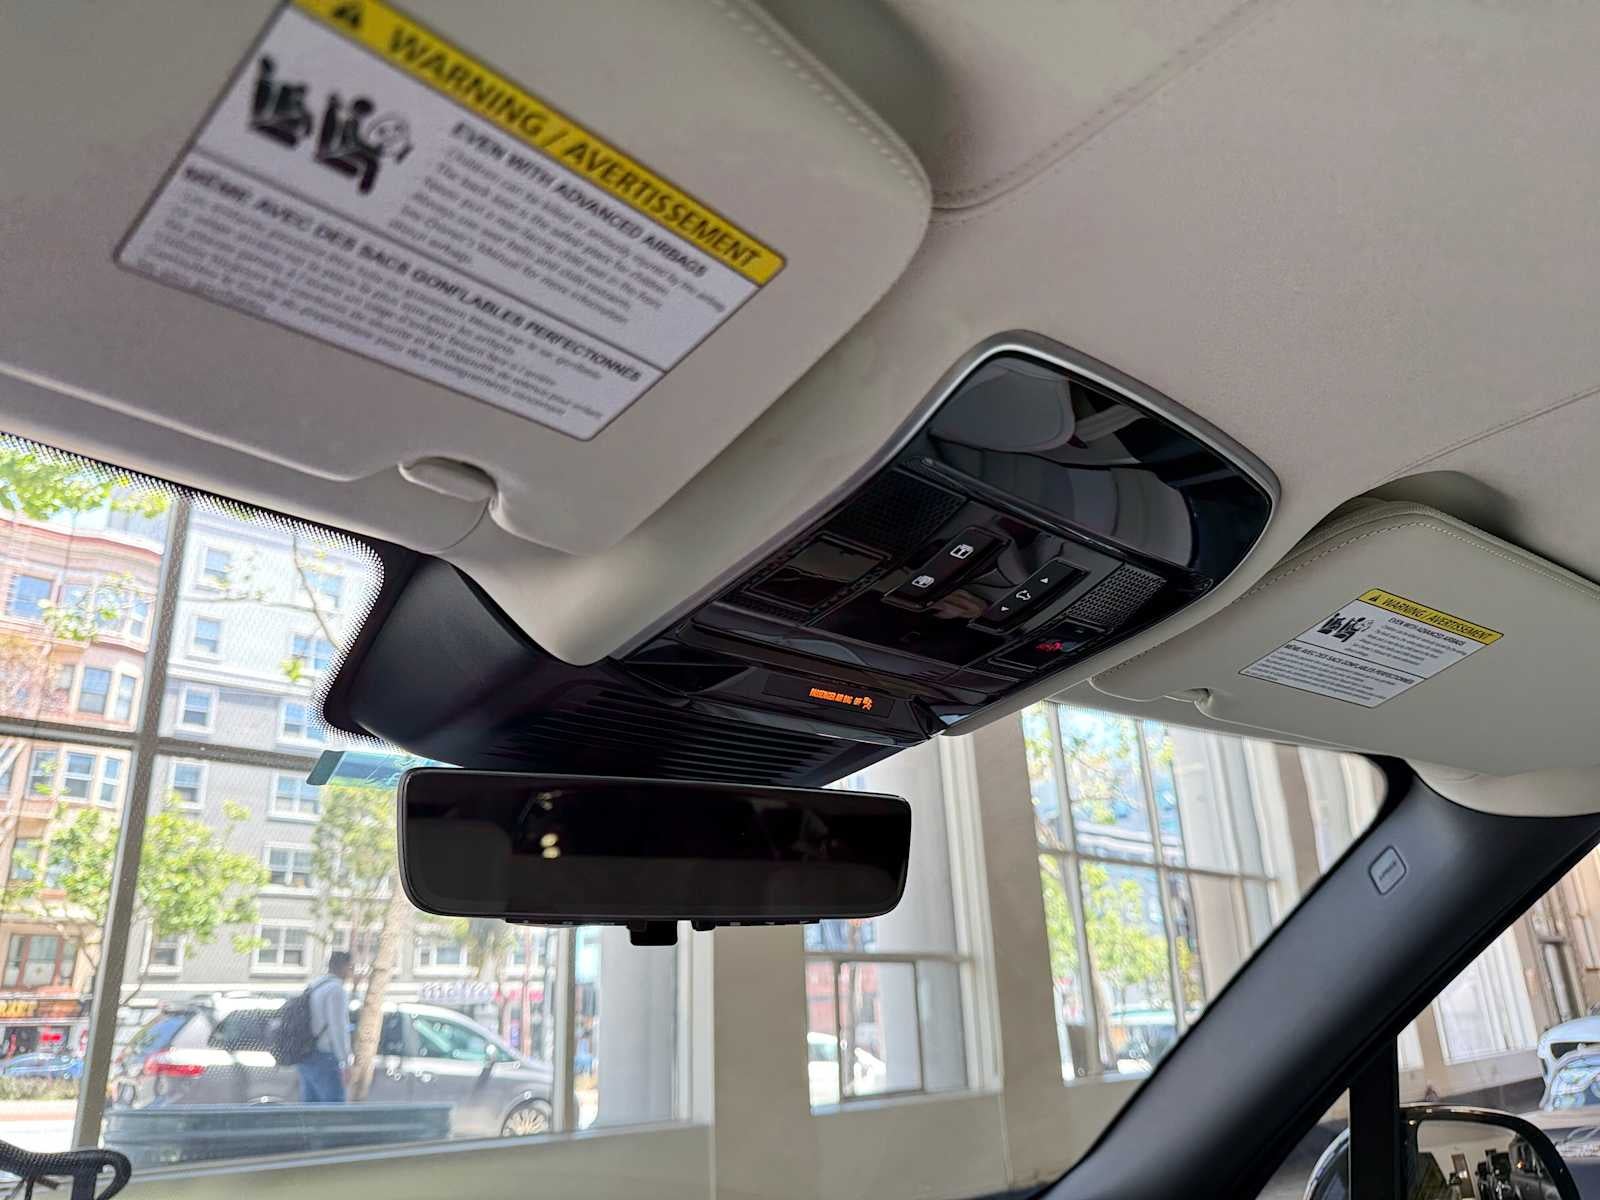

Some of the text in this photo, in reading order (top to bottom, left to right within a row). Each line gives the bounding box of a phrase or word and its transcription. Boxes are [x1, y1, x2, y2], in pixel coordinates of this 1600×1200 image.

[388, 25, 548, 138] WARNING
[563, 141, 760, 270] AVERTISSEMENT
[452, 122, 503, 160] EVEN
[503, 151, 558, 185] WITH
[556, 185, 642, 238] ADVANCED
[642, 235, 708, 277] AIRBAGS
[314, 224, 359, 249] DES
[359, 243, 413, 273] SACS
[411, 267, 526, 326] GONFLABLES
[1382, 597, 1426, 618] WARNING
[1428, 615, 1492, 640] AVERTISSEMENT
